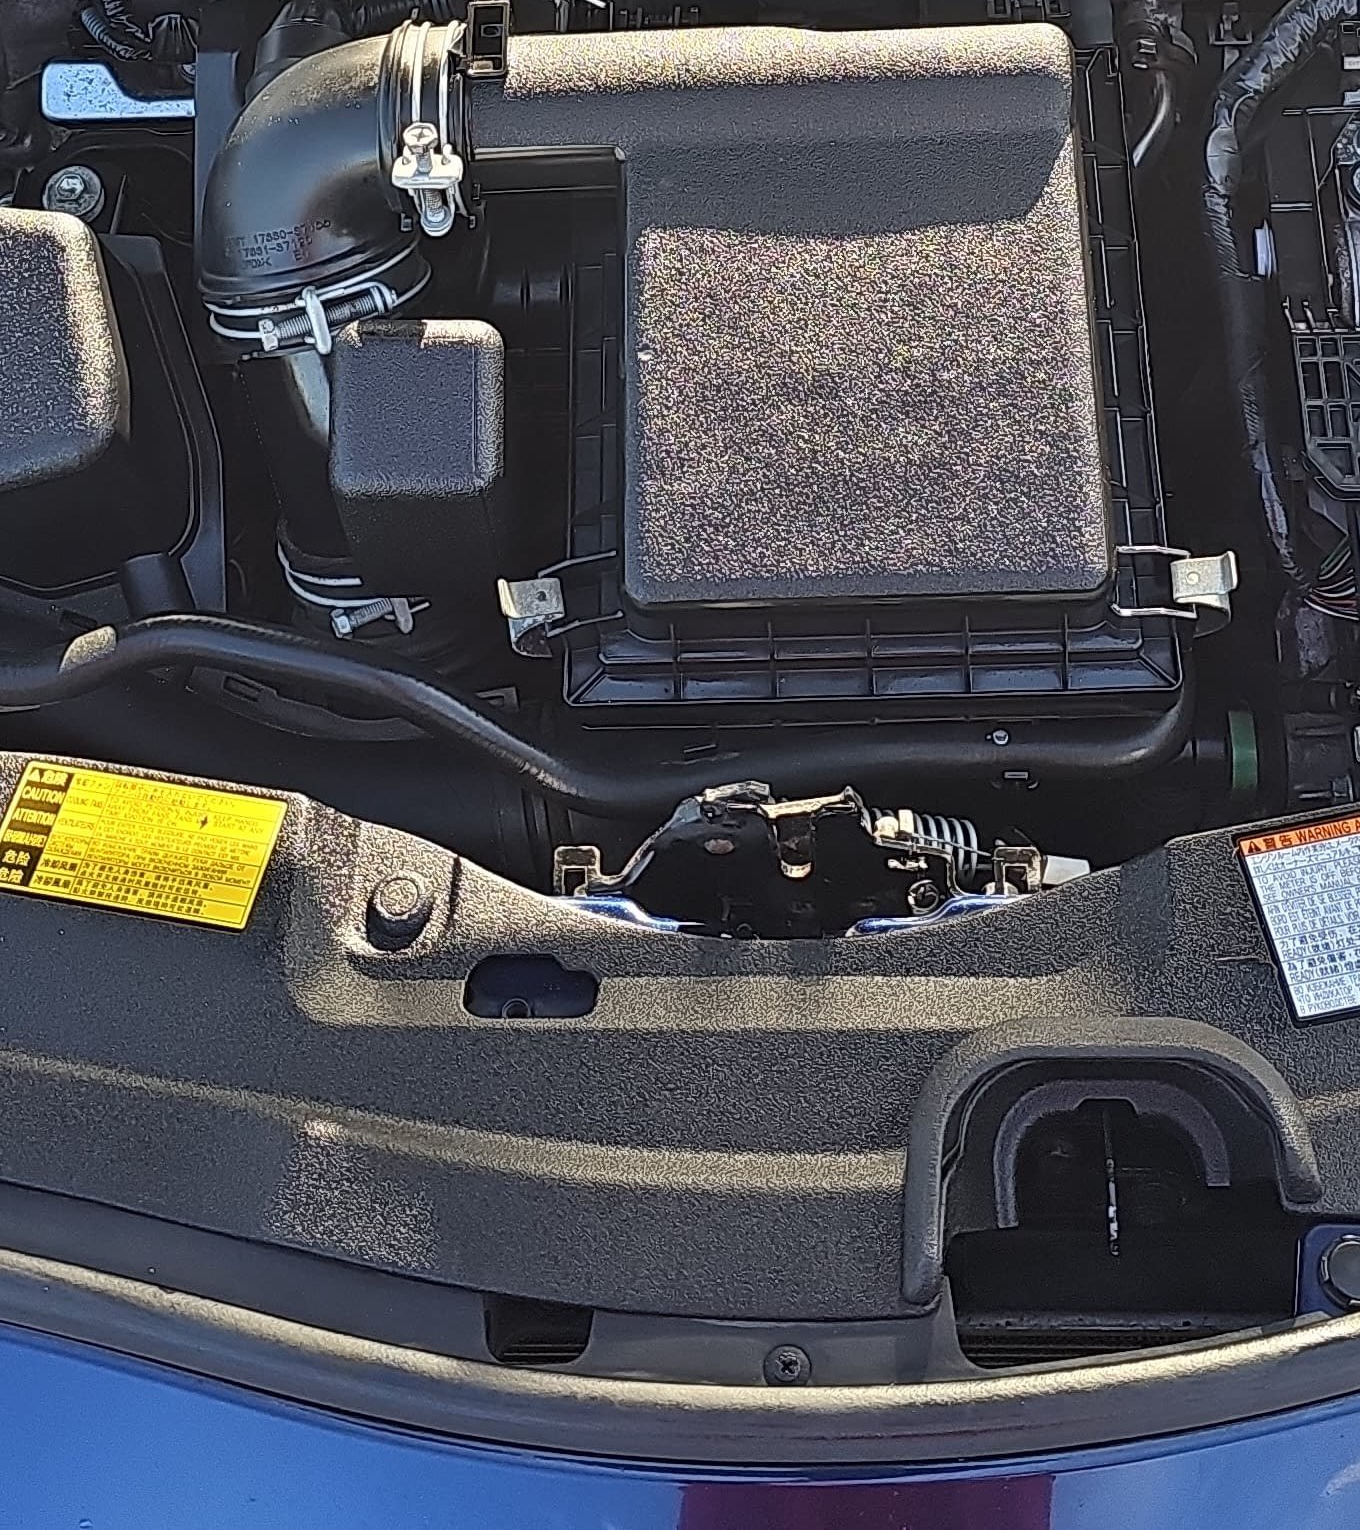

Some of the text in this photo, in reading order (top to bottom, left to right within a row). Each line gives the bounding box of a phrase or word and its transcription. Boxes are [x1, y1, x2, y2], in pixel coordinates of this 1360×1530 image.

[20, 785, 66, 804] CAUTION
[11, 807, 57, 826] ATTENTION
[1295, 821, 1352, 843] WARNING
[1256, 875, 1269, 885] TO
[1271, 869, 1297, 882] AVOID
[1259, 883, 1276, 894] THE
[1278, 876, 1306, 890] METER
[1308, 874, 1318, 884] IS
[1319, 870, 1336, 881] OFF
[1262, 891, 1278, 902] SEE
[1280, 884, 1317, 899] OWNER'S
[1319, 876, 1352, 891] MANUAL
